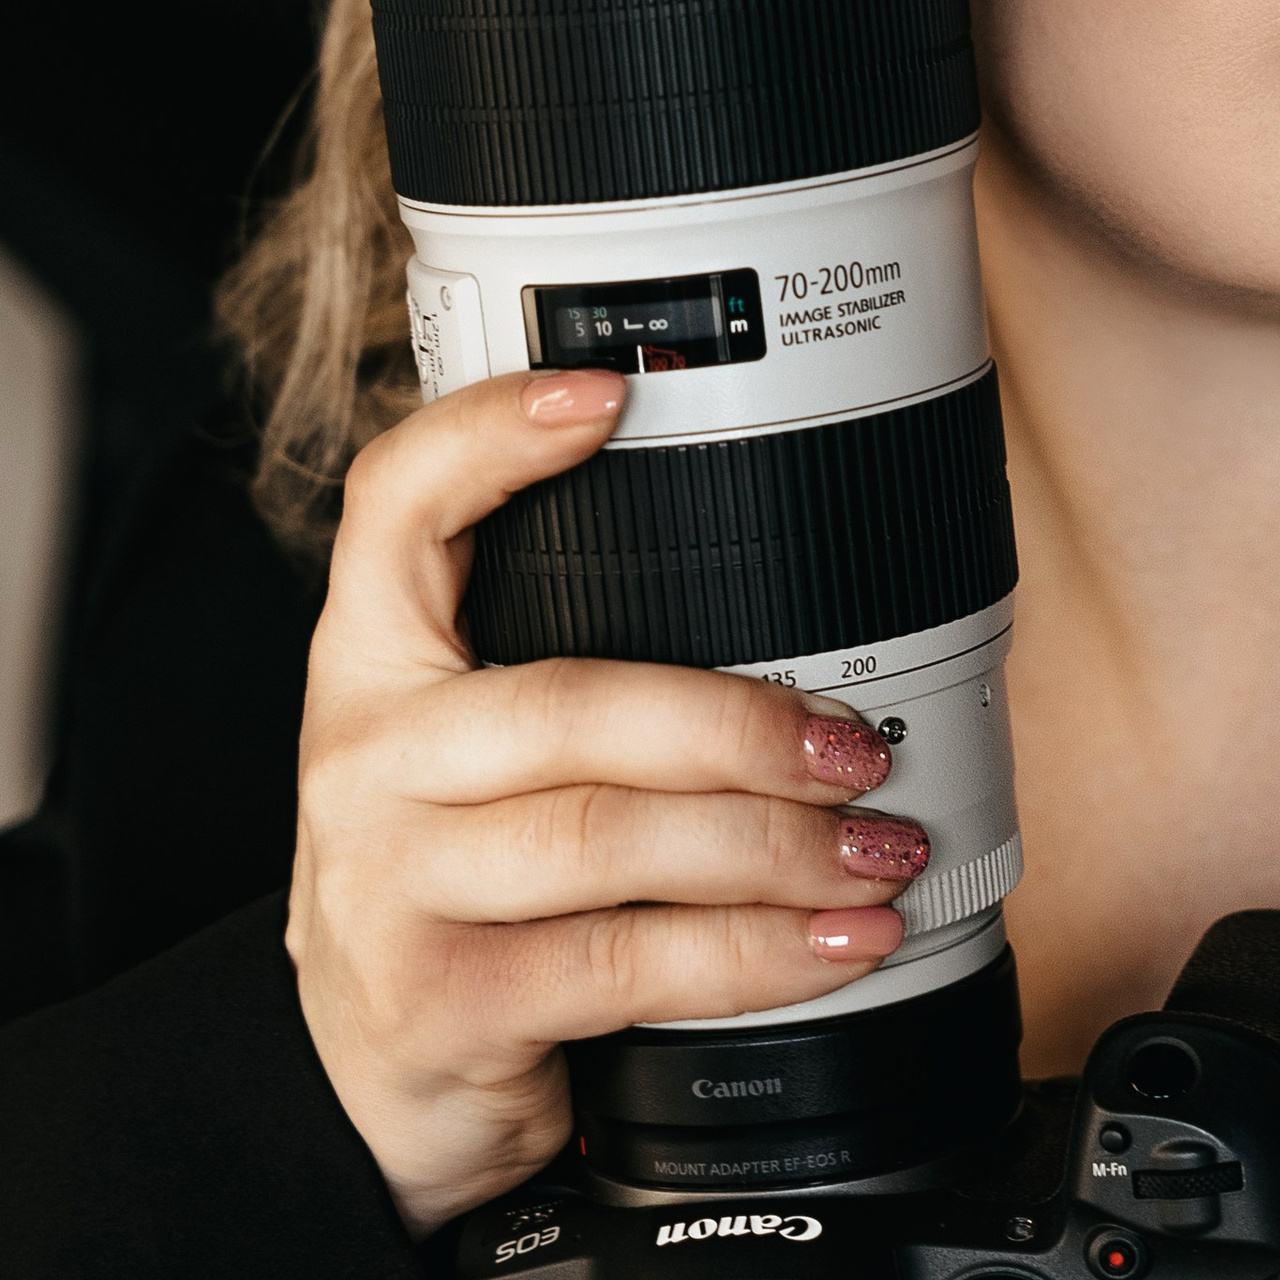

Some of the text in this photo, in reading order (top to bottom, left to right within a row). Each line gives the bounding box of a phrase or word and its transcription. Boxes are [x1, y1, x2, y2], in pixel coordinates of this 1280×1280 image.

[774, 261, 902, 303] 70-200mm
[728, 296, 745, 314] ft
[780, 290, 907, 328] IMAGE STABILIZER
[575, 321, 586, 337] 5
[594, 320, 613, 337] 10
[730, 319, 749, 334] m
[781, 315, 882, 347] ULTRASONIC
[841, 655, 877, 679] 200
[691, 1077, 783, 1099] Canon
[654, 1150, 852, 1177] MOUNT ADAPTER EF-EOS R
[1091, 1161, 1128, 1178] M-Fn
[656, 1214, 824, 1246] Canon
[495, 1225, 561, 1264] EOS
